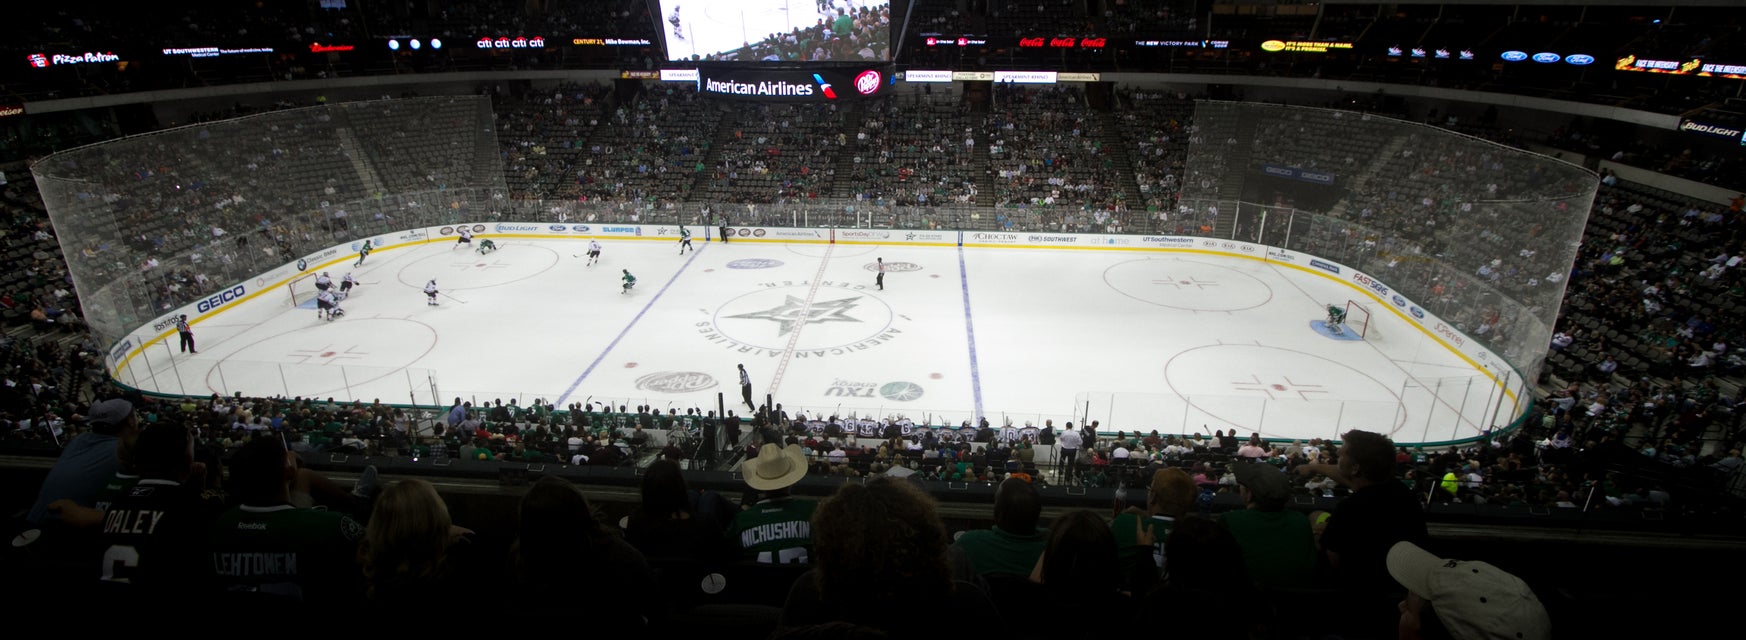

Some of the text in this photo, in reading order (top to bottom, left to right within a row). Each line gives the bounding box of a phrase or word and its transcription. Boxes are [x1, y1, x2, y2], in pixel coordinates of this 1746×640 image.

[476, 38, 493, 48] citi
[494, 38, 510, 48] citi
[511, 38, 527, 48] citi
[529, 38, 545, 48] citi
[52, 54, 84, 64] Pizza
[706, 78, 813, 96] American Airlines
[1684, 122, 1740, 137] BUD LIGHT
[197, 284, 246, 313] GEICO
[695, 321, 902, 359] AMERICAN AIRLINES
[831, 377, 878, 387] energy
[824, 386, 876, 398] TXU
[104, 509, 165, 535] DALEY
[741, 520, 811, 548] NICHUSHKIN
[213, 551, 298, 577] LEHTONEN
